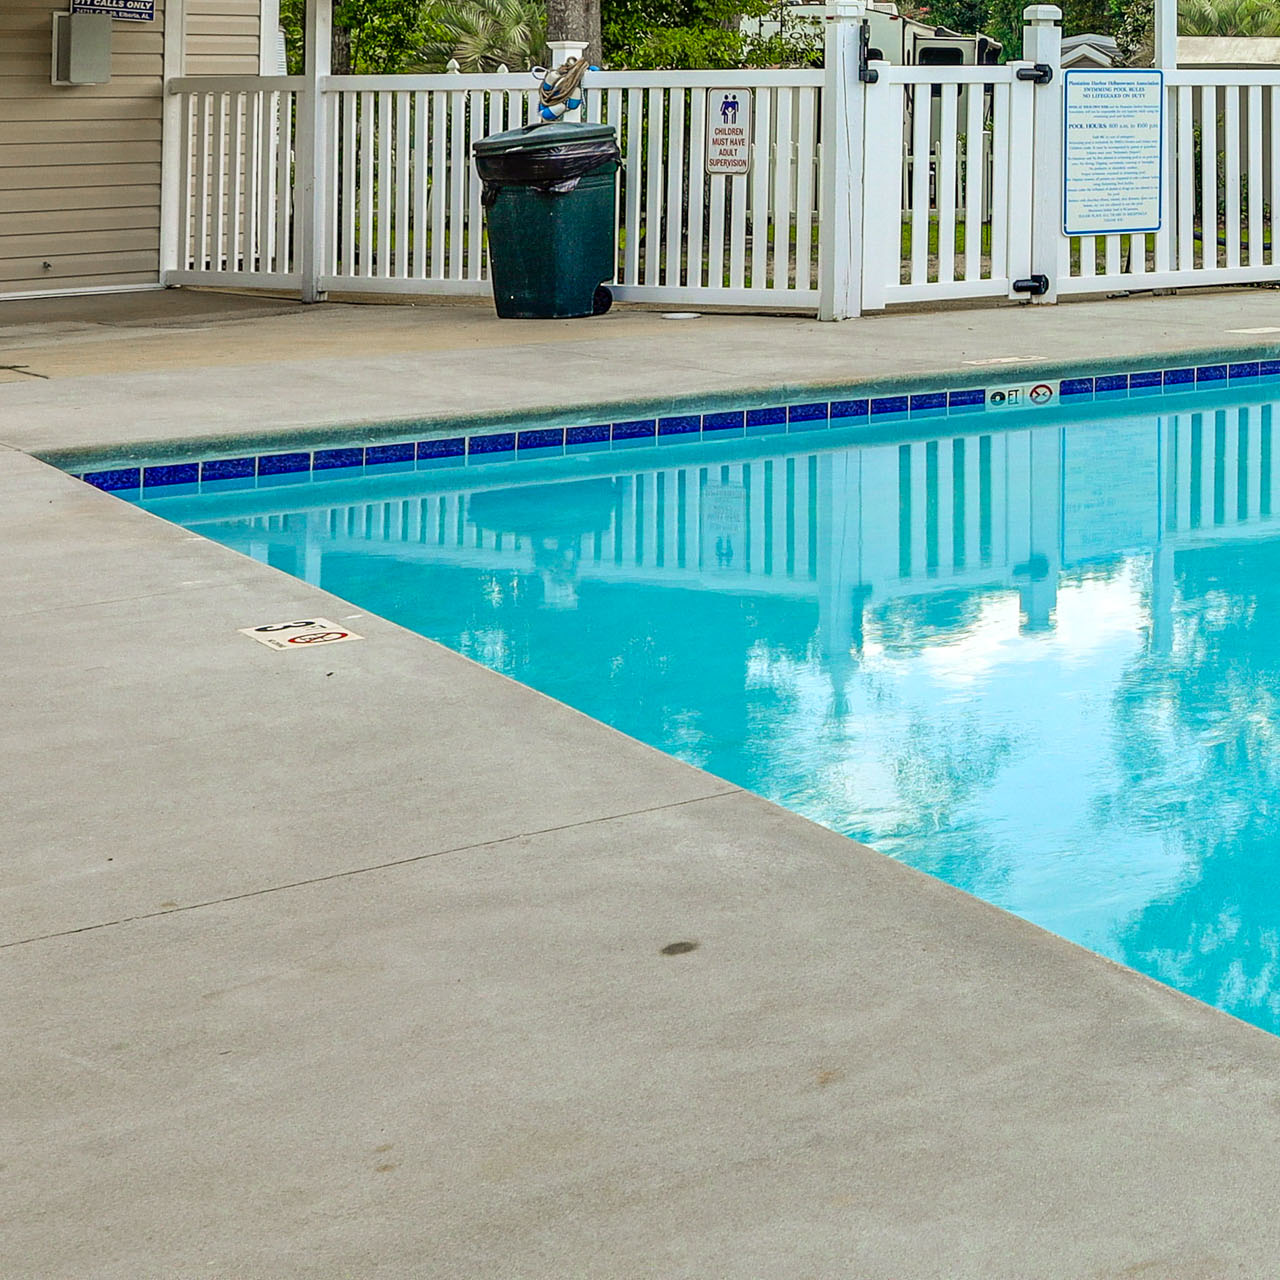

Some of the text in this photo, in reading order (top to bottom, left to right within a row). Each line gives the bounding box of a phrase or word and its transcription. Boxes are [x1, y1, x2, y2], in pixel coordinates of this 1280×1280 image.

[126, 1, 152, 10] ONLY
[730, 138, 745, 146] HAVE
[709, 159, 747, 167] SUPERVISION
